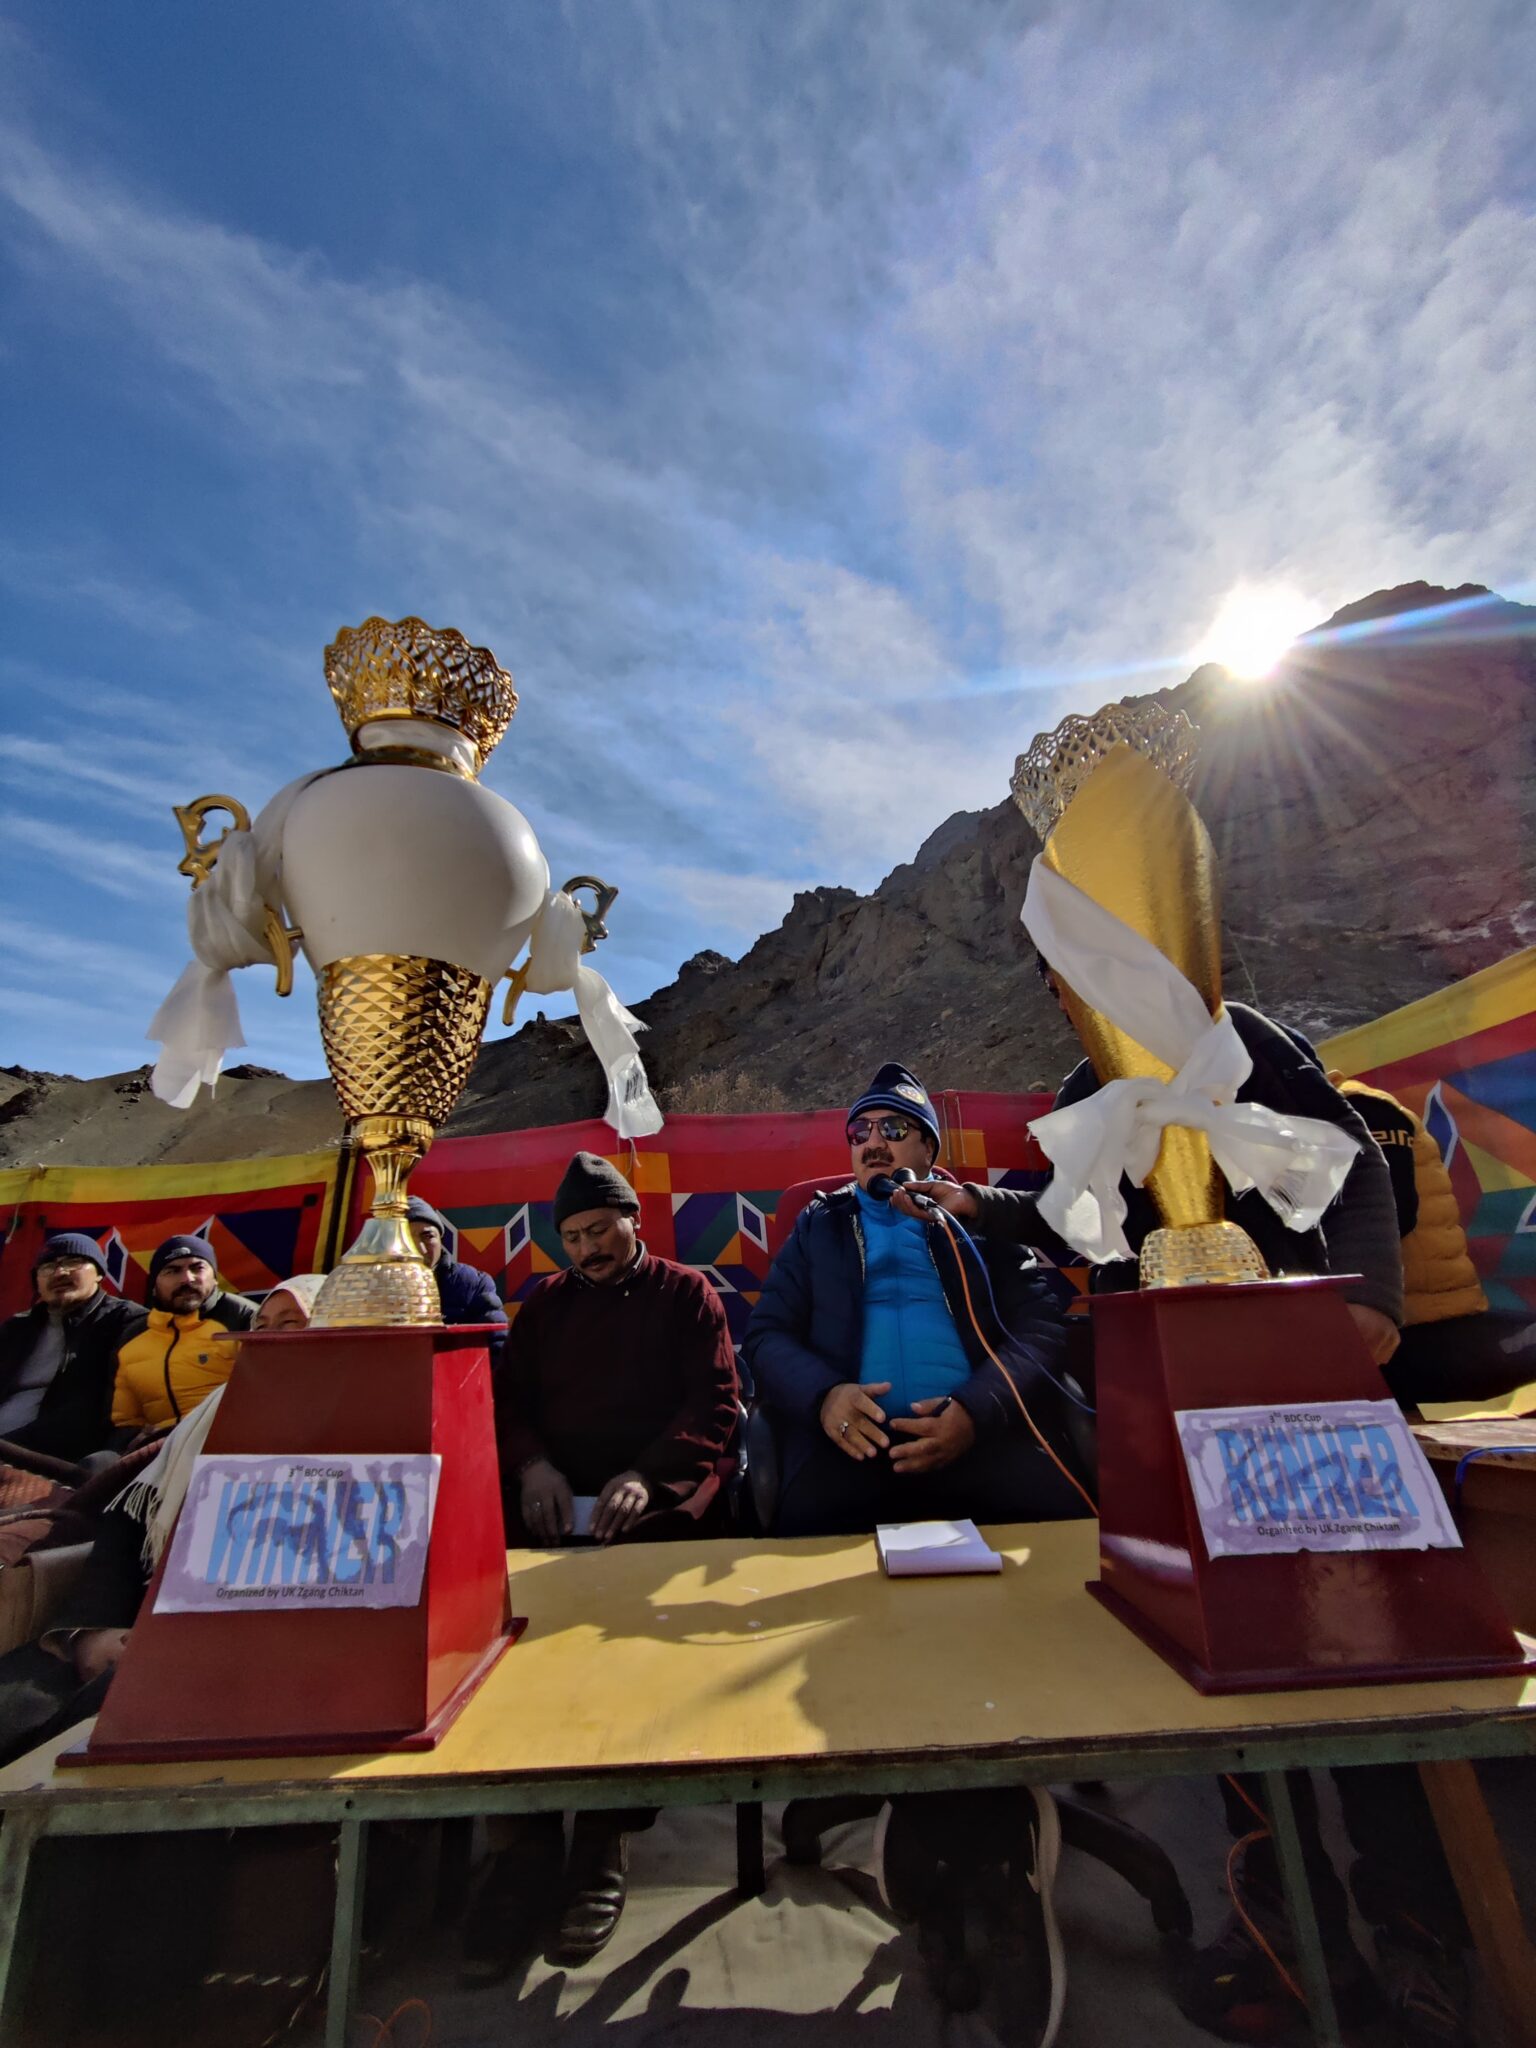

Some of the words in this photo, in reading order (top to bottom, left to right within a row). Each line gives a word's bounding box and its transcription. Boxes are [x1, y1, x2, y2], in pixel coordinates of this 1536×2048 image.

[1283, 1414, 1303, 1422] BDC
[1304, 1413, 1322, 1423] Cup
[304, 1468, 324, 1477] BDC
[326, 1468, 344, 1479] Cup
[1214, 1424, 1419, 1522] RUNNER
[205, 1481, 406, 1584] WINNER
[1305, 1524, 1317, 1535] by
[216, 1587, 265, 1599] Organized
[267, 1587, 279, 1599] by
[281, 1586, 297, 1597] UK
[298, 1586, 326, 1599] Zgang
[328, 1586, 364, 1597] Chiktan
